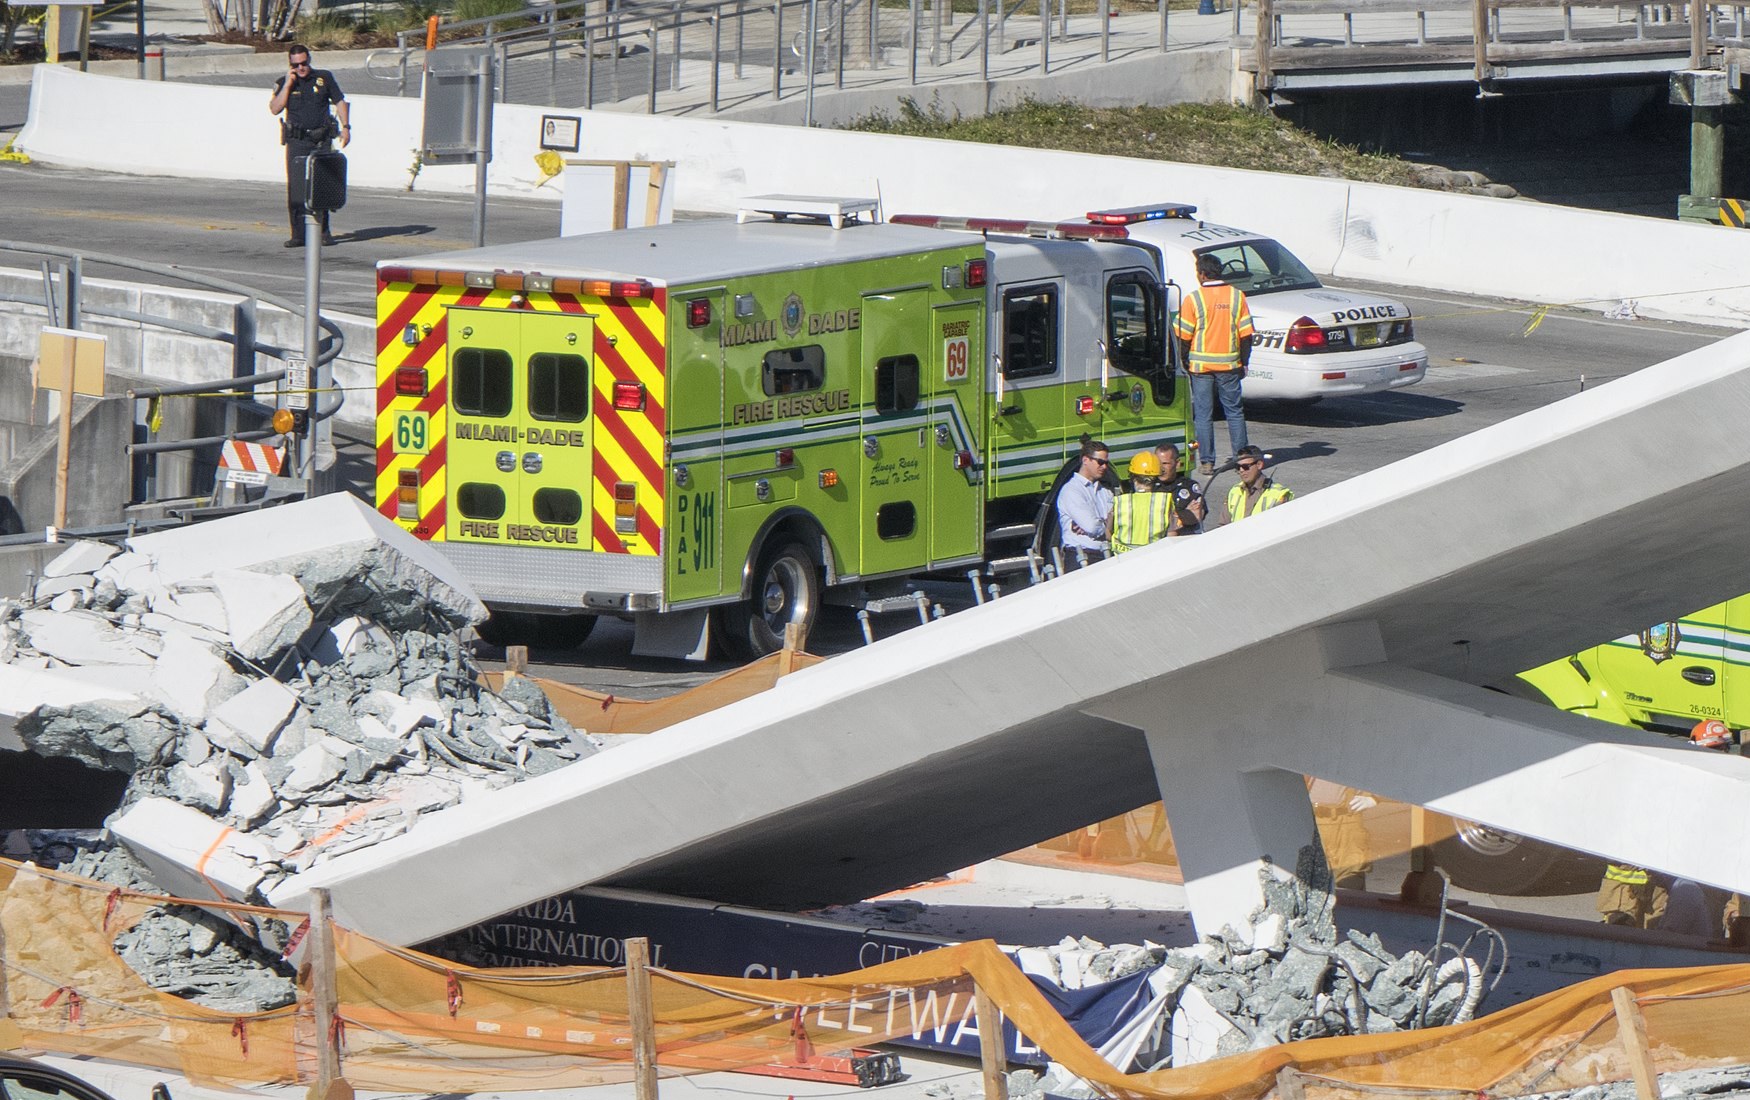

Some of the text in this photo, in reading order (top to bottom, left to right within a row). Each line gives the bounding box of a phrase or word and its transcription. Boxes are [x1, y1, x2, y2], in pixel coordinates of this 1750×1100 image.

[720, 308, 860, 347] MIAMI DADE
[1332, 305, 1396, 323] POLICE
[947, 341, 966, 377] 69
[734, 389, 850, 425] FIRE RESCUE
[397, 415, 425, 449] 69
[455, 422, 584, 447] MIAMI-DADE
[460, 521, 579, 544] FIRE RESCUE
[677, 495, 689, 575] DIAL
[693, 491, 715, 572] 911
[1689, 704, 1722, 716] 26-0324
